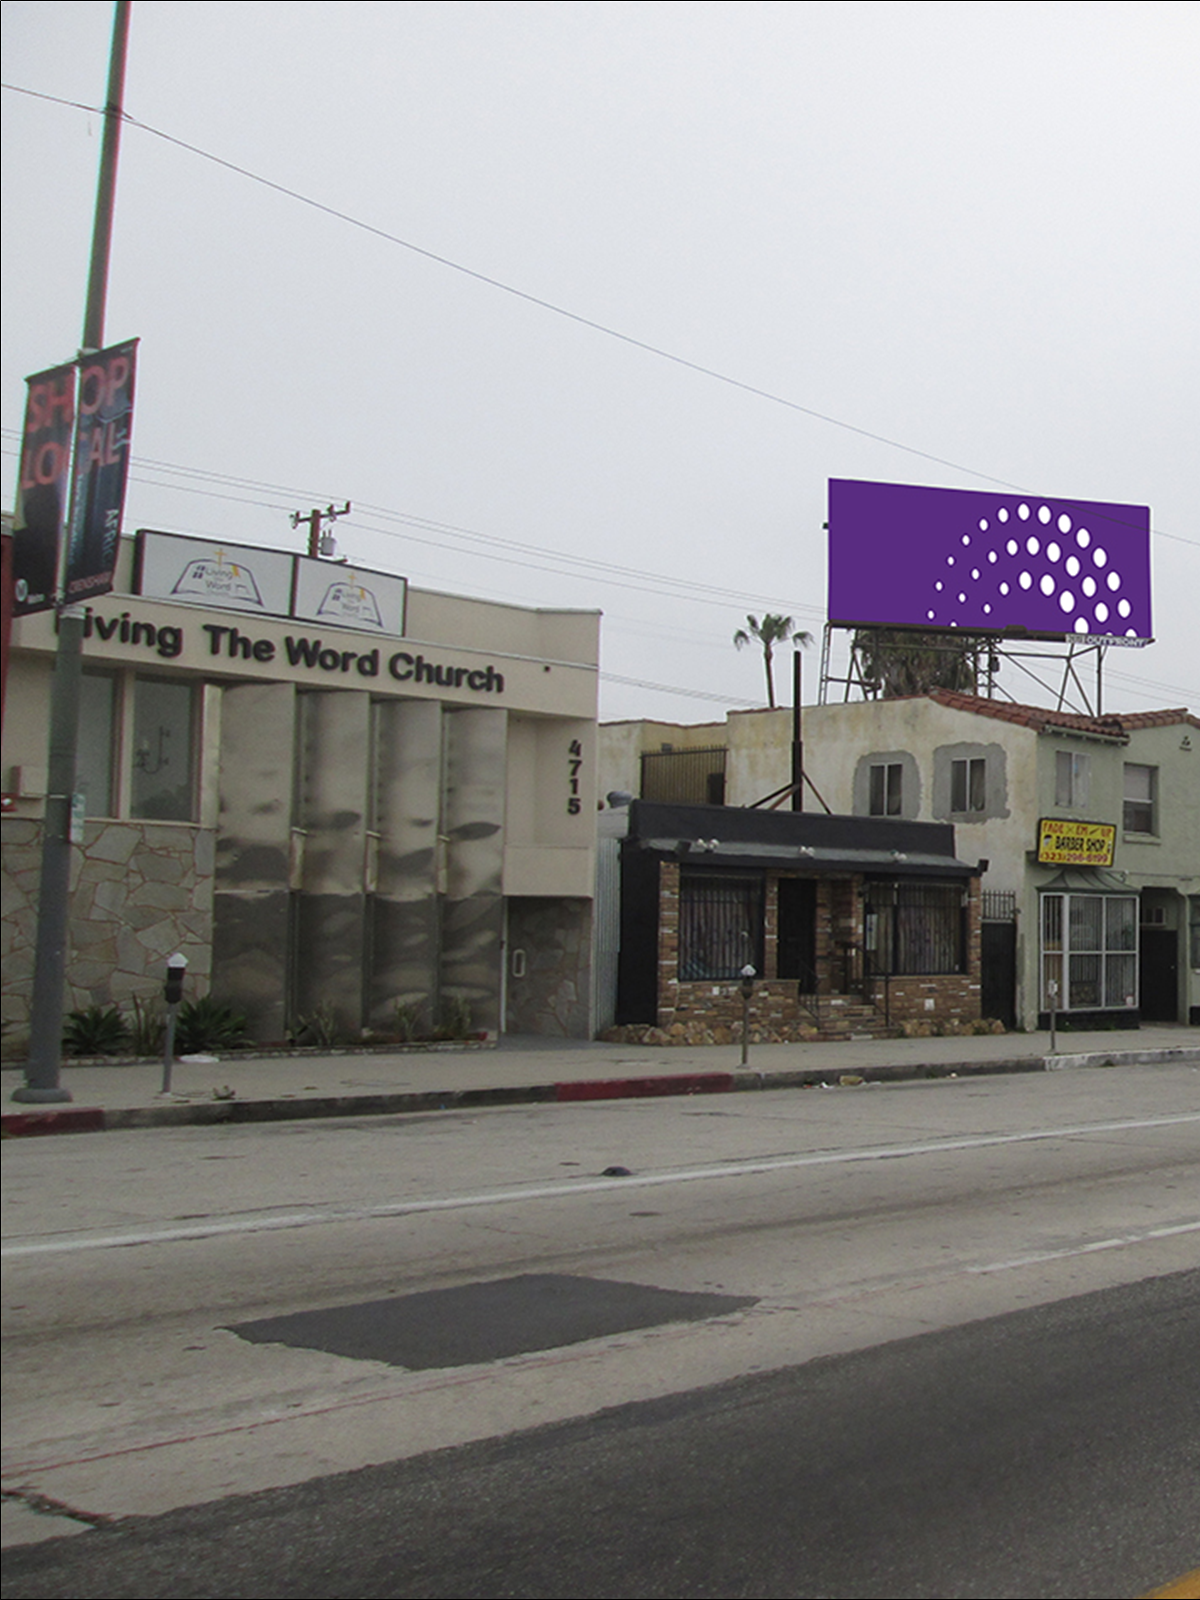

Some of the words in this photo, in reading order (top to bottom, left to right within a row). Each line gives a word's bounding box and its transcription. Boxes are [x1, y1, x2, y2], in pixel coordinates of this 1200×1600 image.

[54, 607, 183, 658] iving
[202, 623, 275, 664] The
[284, 635, 379, 678] Word
[388, 652, 505, 693] Church
[567, 739, 580, 816] 4715
[1055, 835, 1085, 852] BARBER
[1086, 838, 1105, 852] SHOP
